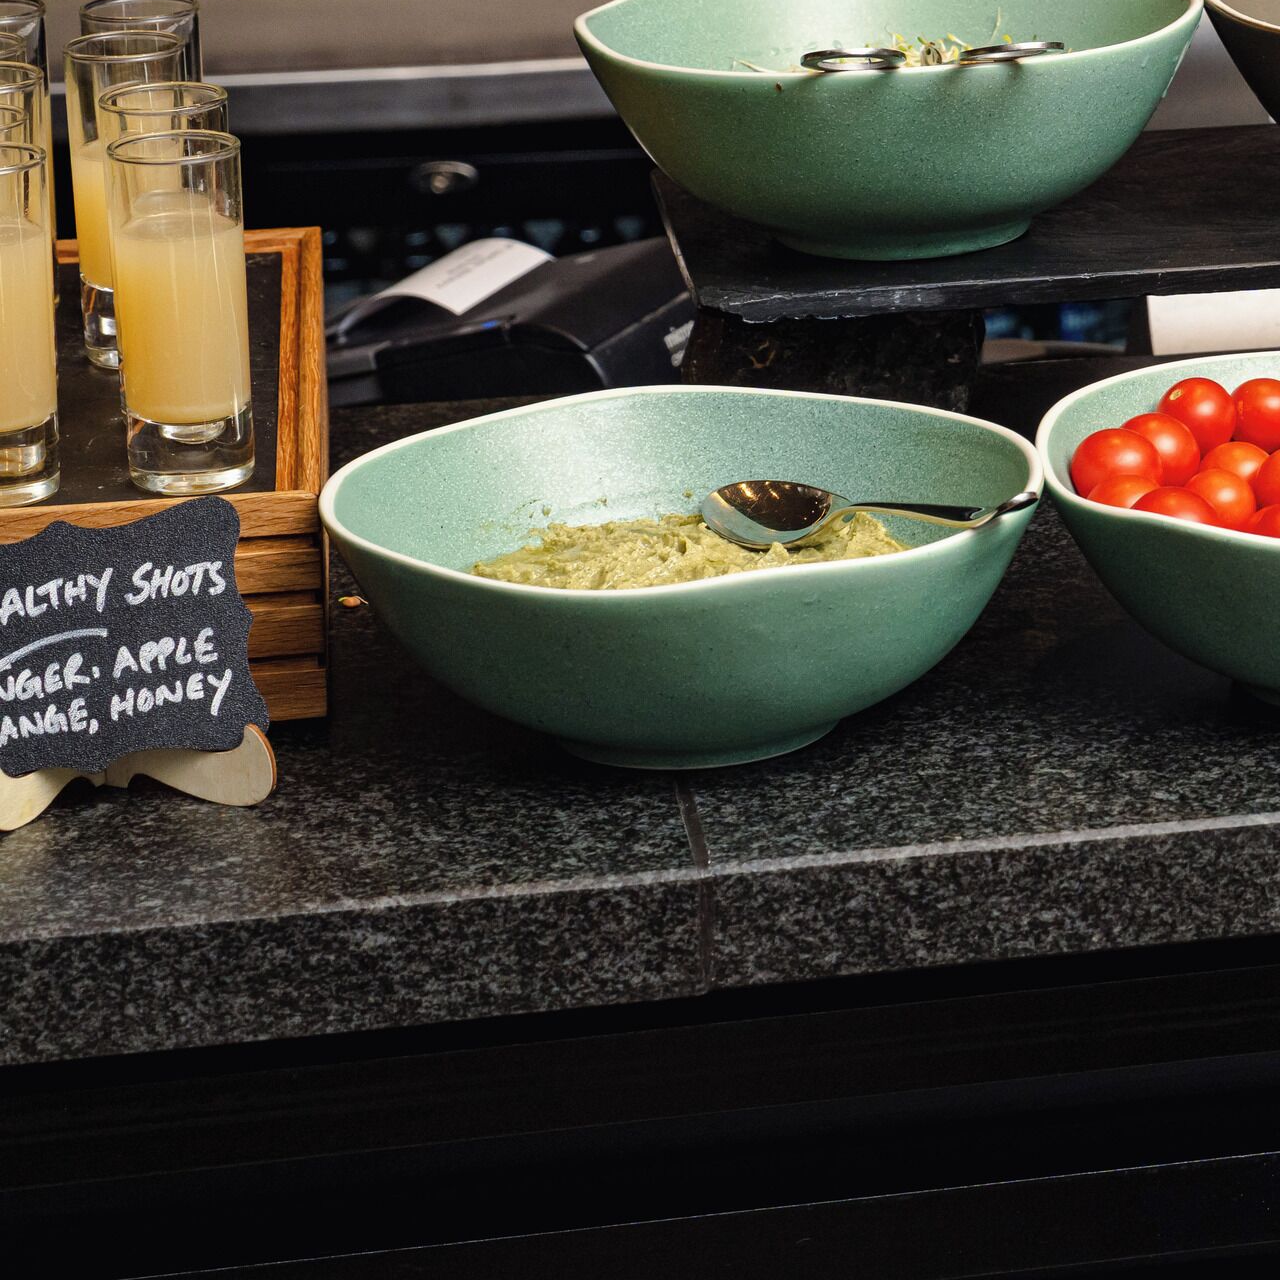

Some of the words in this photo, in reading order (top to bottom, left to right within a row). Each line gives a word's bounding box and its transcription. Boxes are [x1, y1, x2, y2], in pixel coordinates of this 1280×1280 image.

[0, 568, 113, 625] ALTHY
[125, 561, 227, 605] SHOTS
[113, 627, 219, 678] APPLE
[0, 697, 99, 747] ANGE,
[110, 668, 232, 721] HONEY
